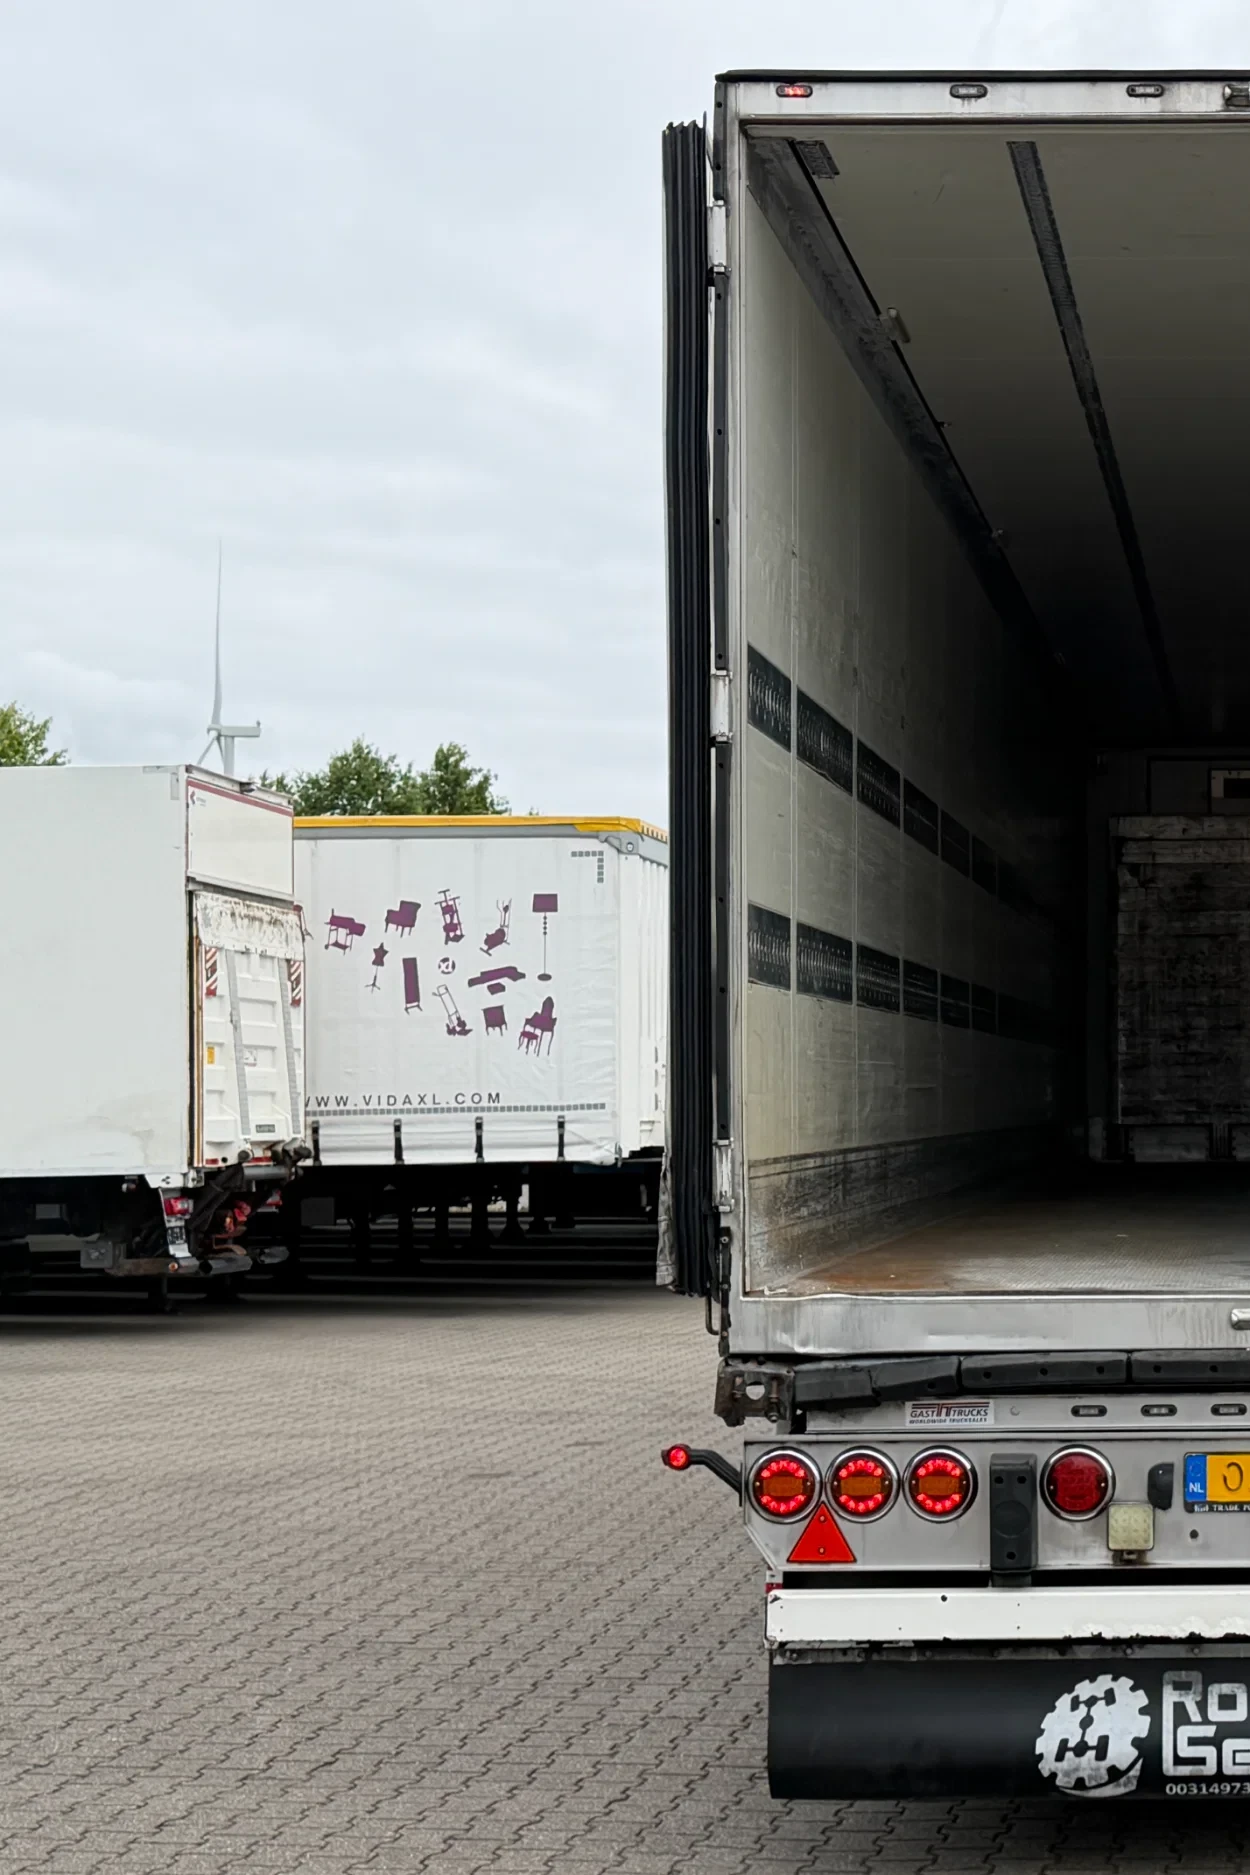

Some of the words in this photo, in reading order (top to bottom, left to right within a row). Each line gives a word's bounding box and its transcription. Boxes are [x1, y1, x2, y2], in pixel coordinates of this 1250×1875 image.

[910, 1409, 937, 1418] GAST
[952, 1408, 989, 1417] TRUCKS
[1189, 1482, 1204, 1493] NL
